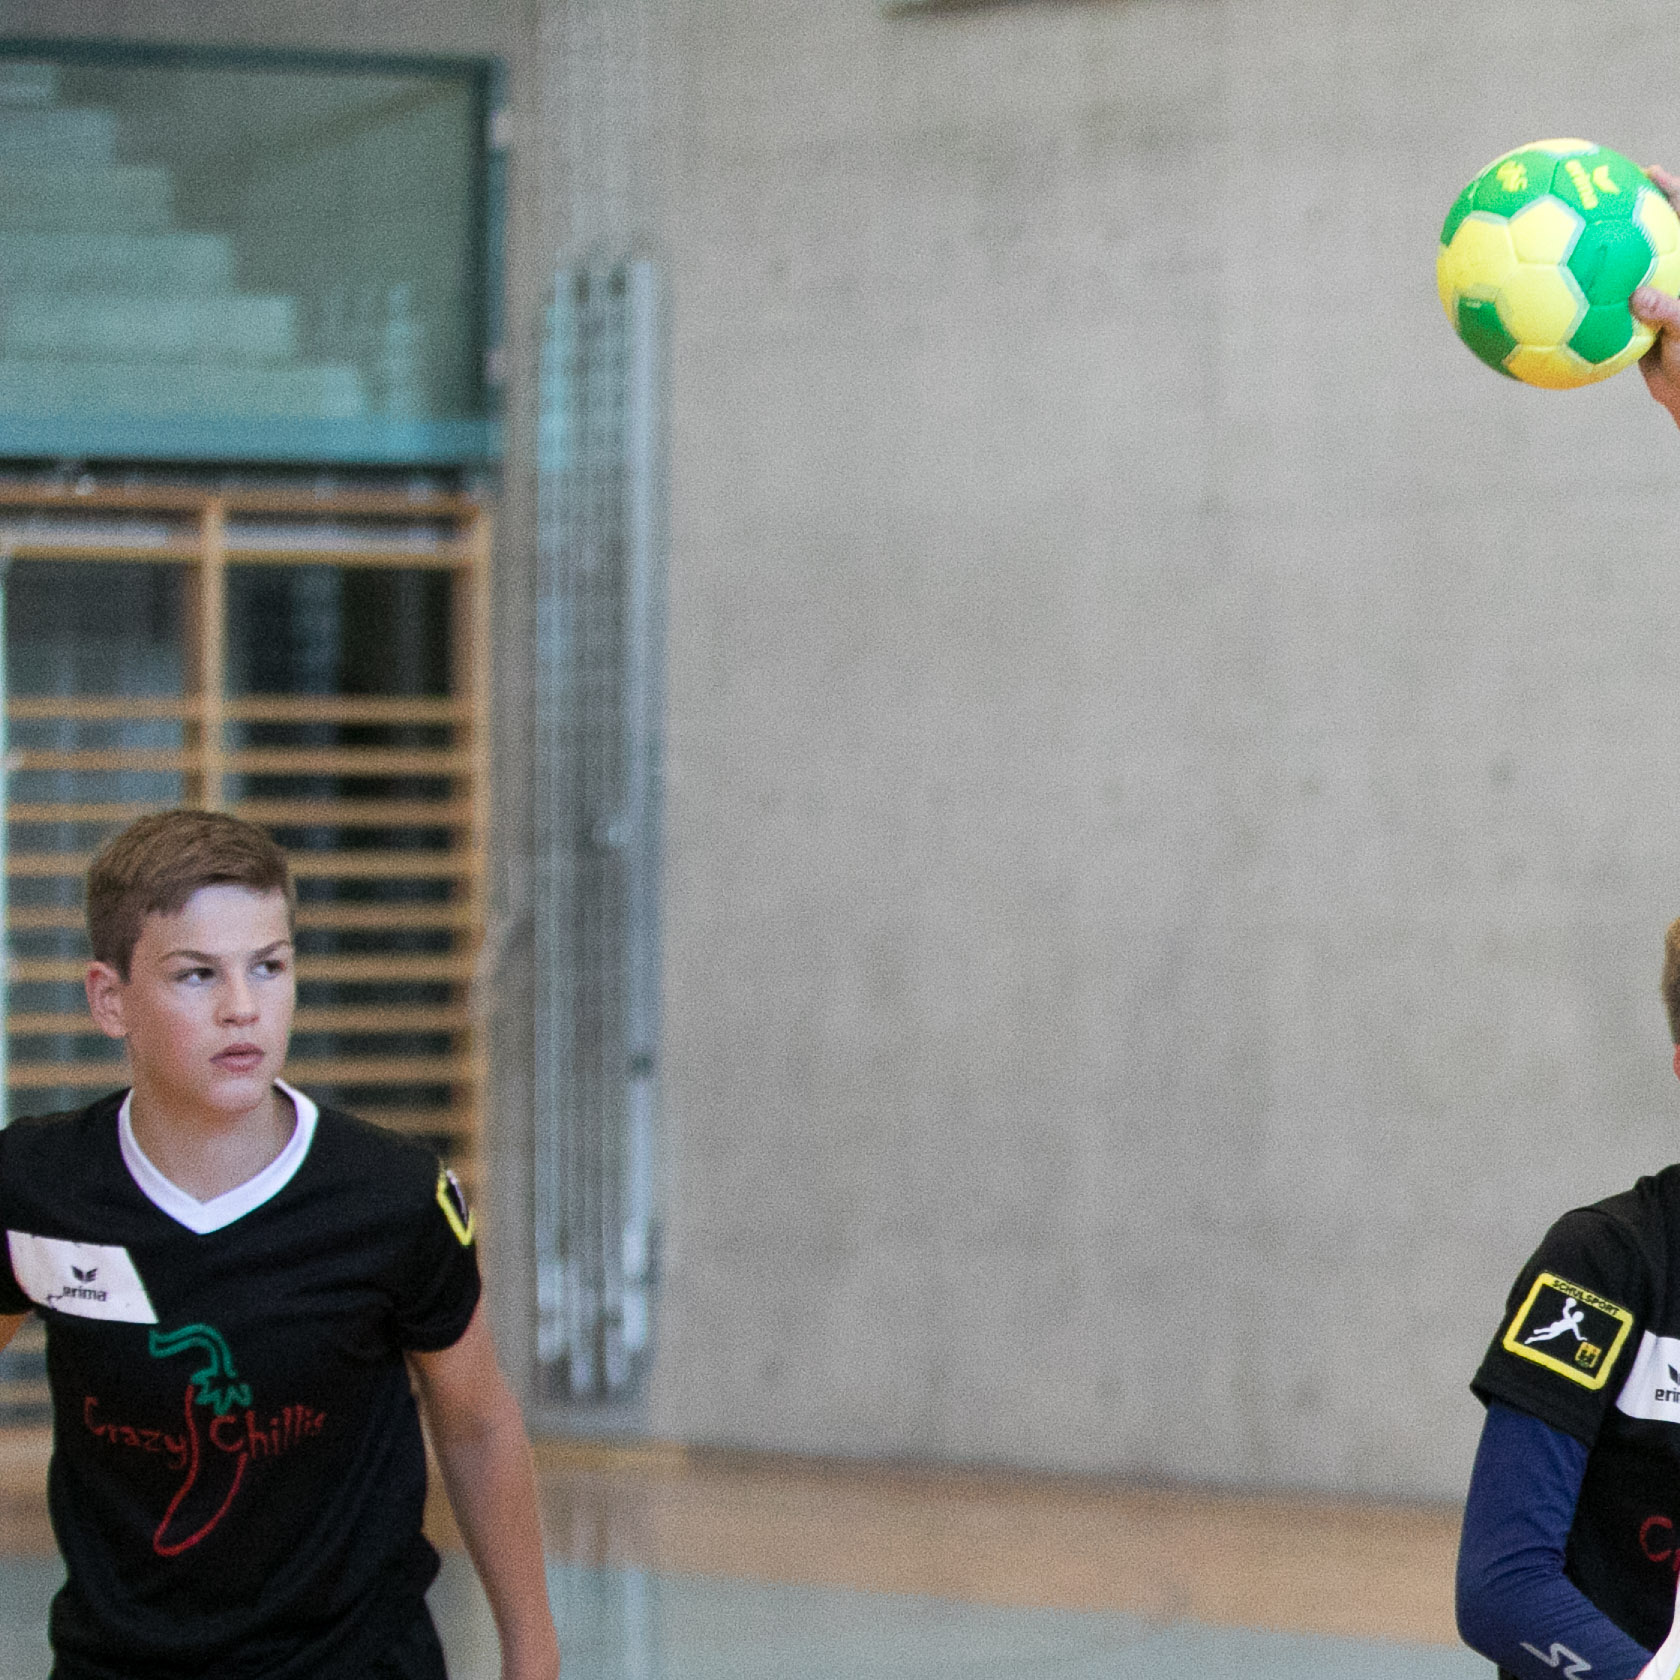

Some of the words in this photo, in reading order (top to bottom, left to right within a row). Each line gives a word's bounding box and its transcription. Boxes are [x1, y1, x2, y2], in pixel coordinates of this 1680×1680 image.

[63, 1285, 107, 1302] erima
[1552, 1279, 1619, 1317] SCHULSPORT
[84, 1396, 187, 1470] Crazy
